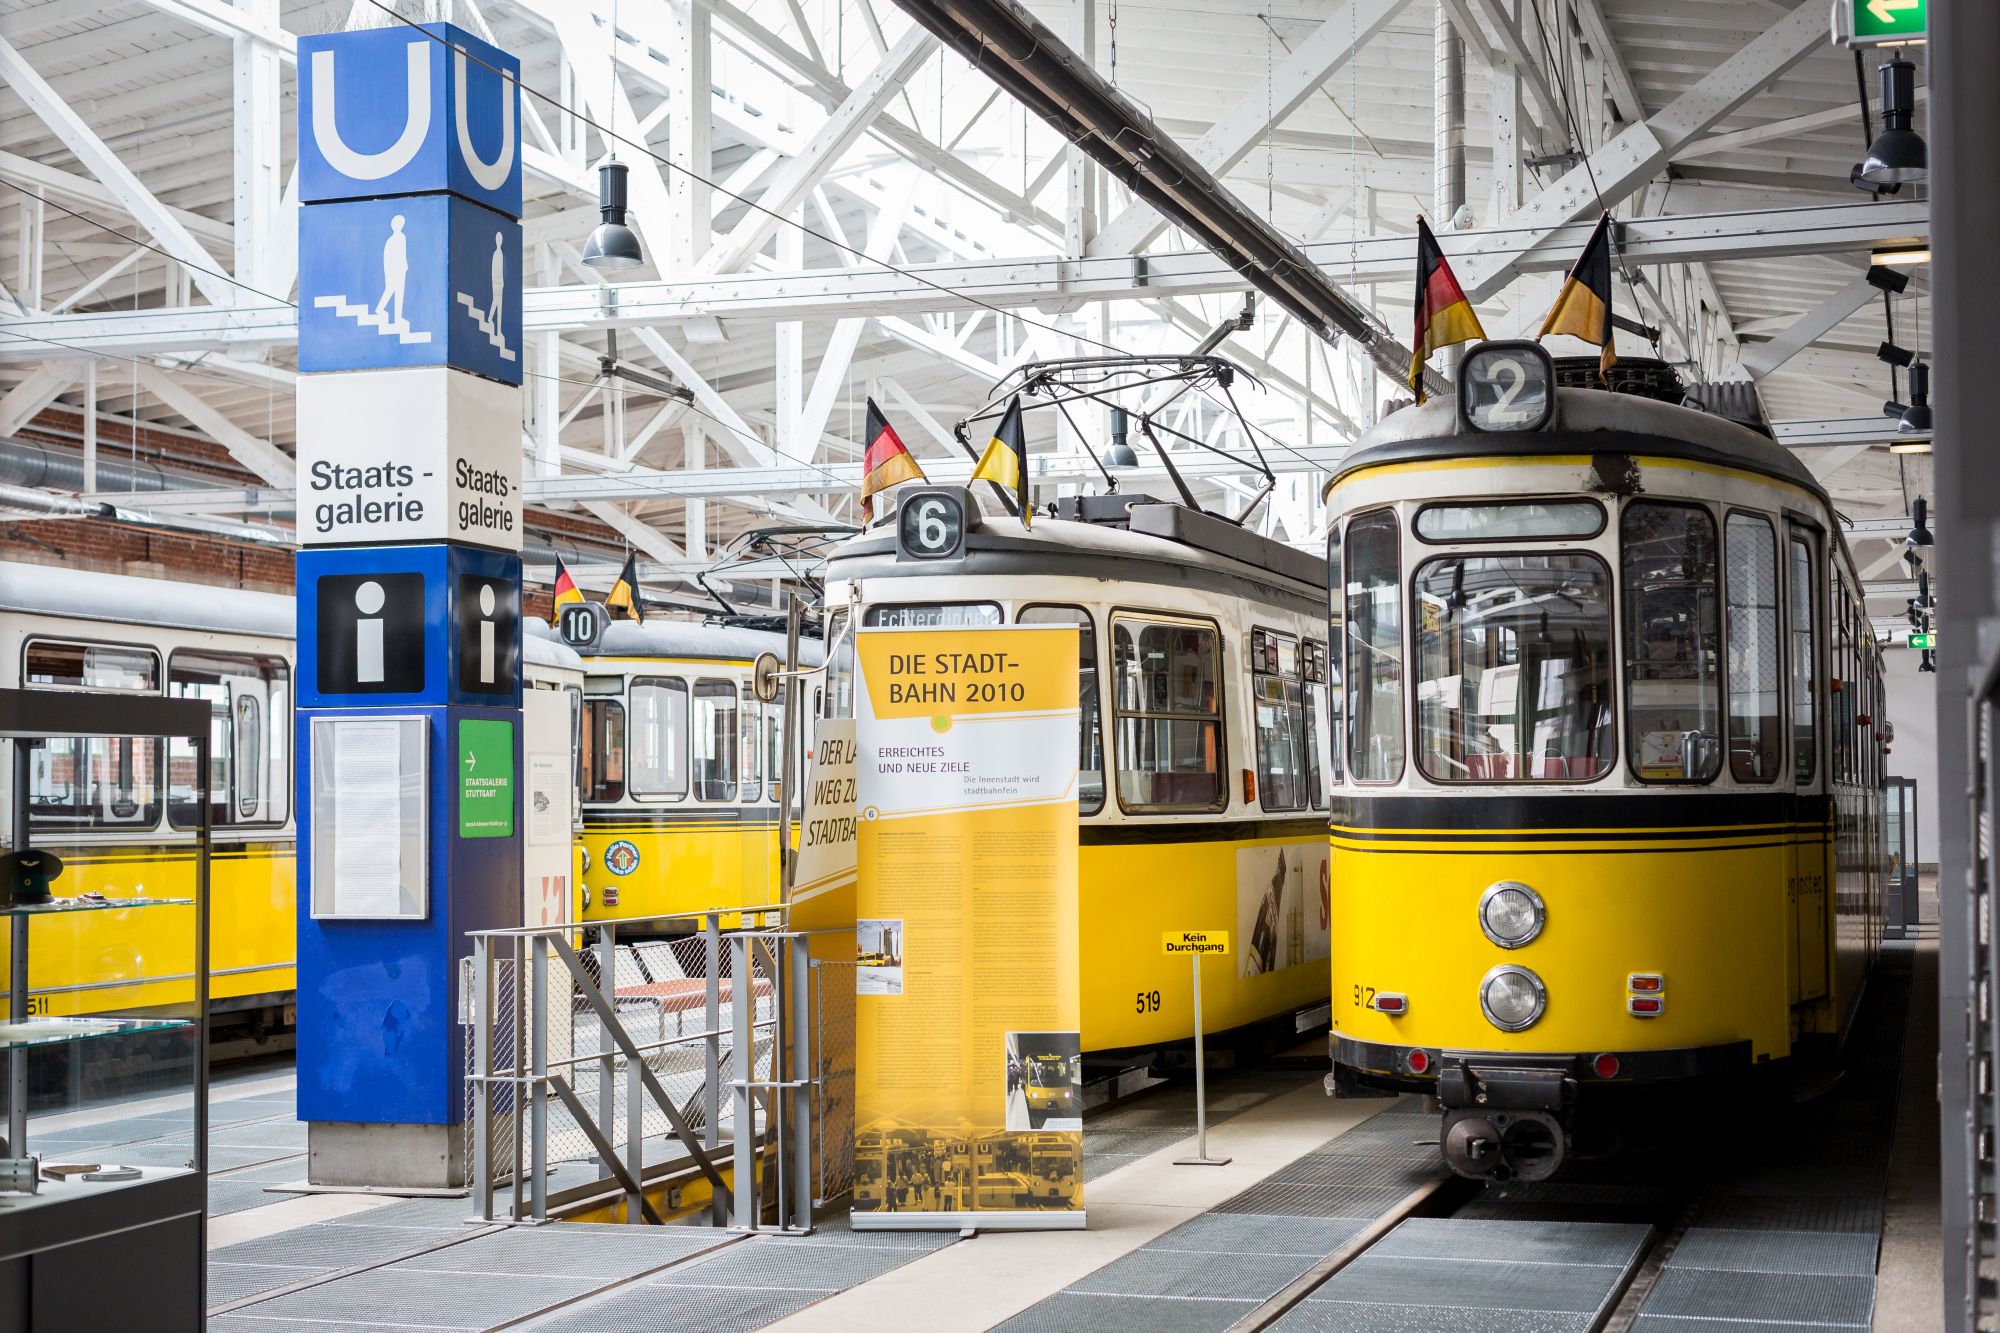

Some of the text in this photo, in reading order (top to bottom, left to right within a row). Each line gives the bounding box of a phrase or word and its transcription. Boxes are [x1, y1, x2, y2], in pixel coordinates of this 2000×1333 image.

[312, 41, 431, 180] U
[454, 43, 515, 191] U
[1486, 359, 1528, 424] 2
[315, 492, 424, 533] galerie
[459, 497, 513, 532] galerie
[918, 500, 947, 549] 6
[568, 611, 592, 641] 10
[889, 653, 1020, 675] DIE STADT-
[889, 682, 1026, 704] BAHN 2010
[819, 739, 843, 766] DER
[878, 746, 945, 758] ERREICHTES
[878, 761, 970, 774] UND NEUE ZIELE
[963, 775, 1040, 784] Die Innenstadt wird
[465, 778, 508, 787] STAATSGALERIE
[465, 789, 497, 798] STUTTGART
[814, 778, 842, 806] WEG
[963, 786, 1018, 795] stadtbahnfein
[868, 810, 875, 818] 6
[807, 816, 857, 847] STADTBA
[1166, 942, 1225, 953] Durchgang
[1183, 933, 1207, 942] Kein
[1136, 990, 1161, 1014] 519
[1354, 984, 1376, 1009] 912
